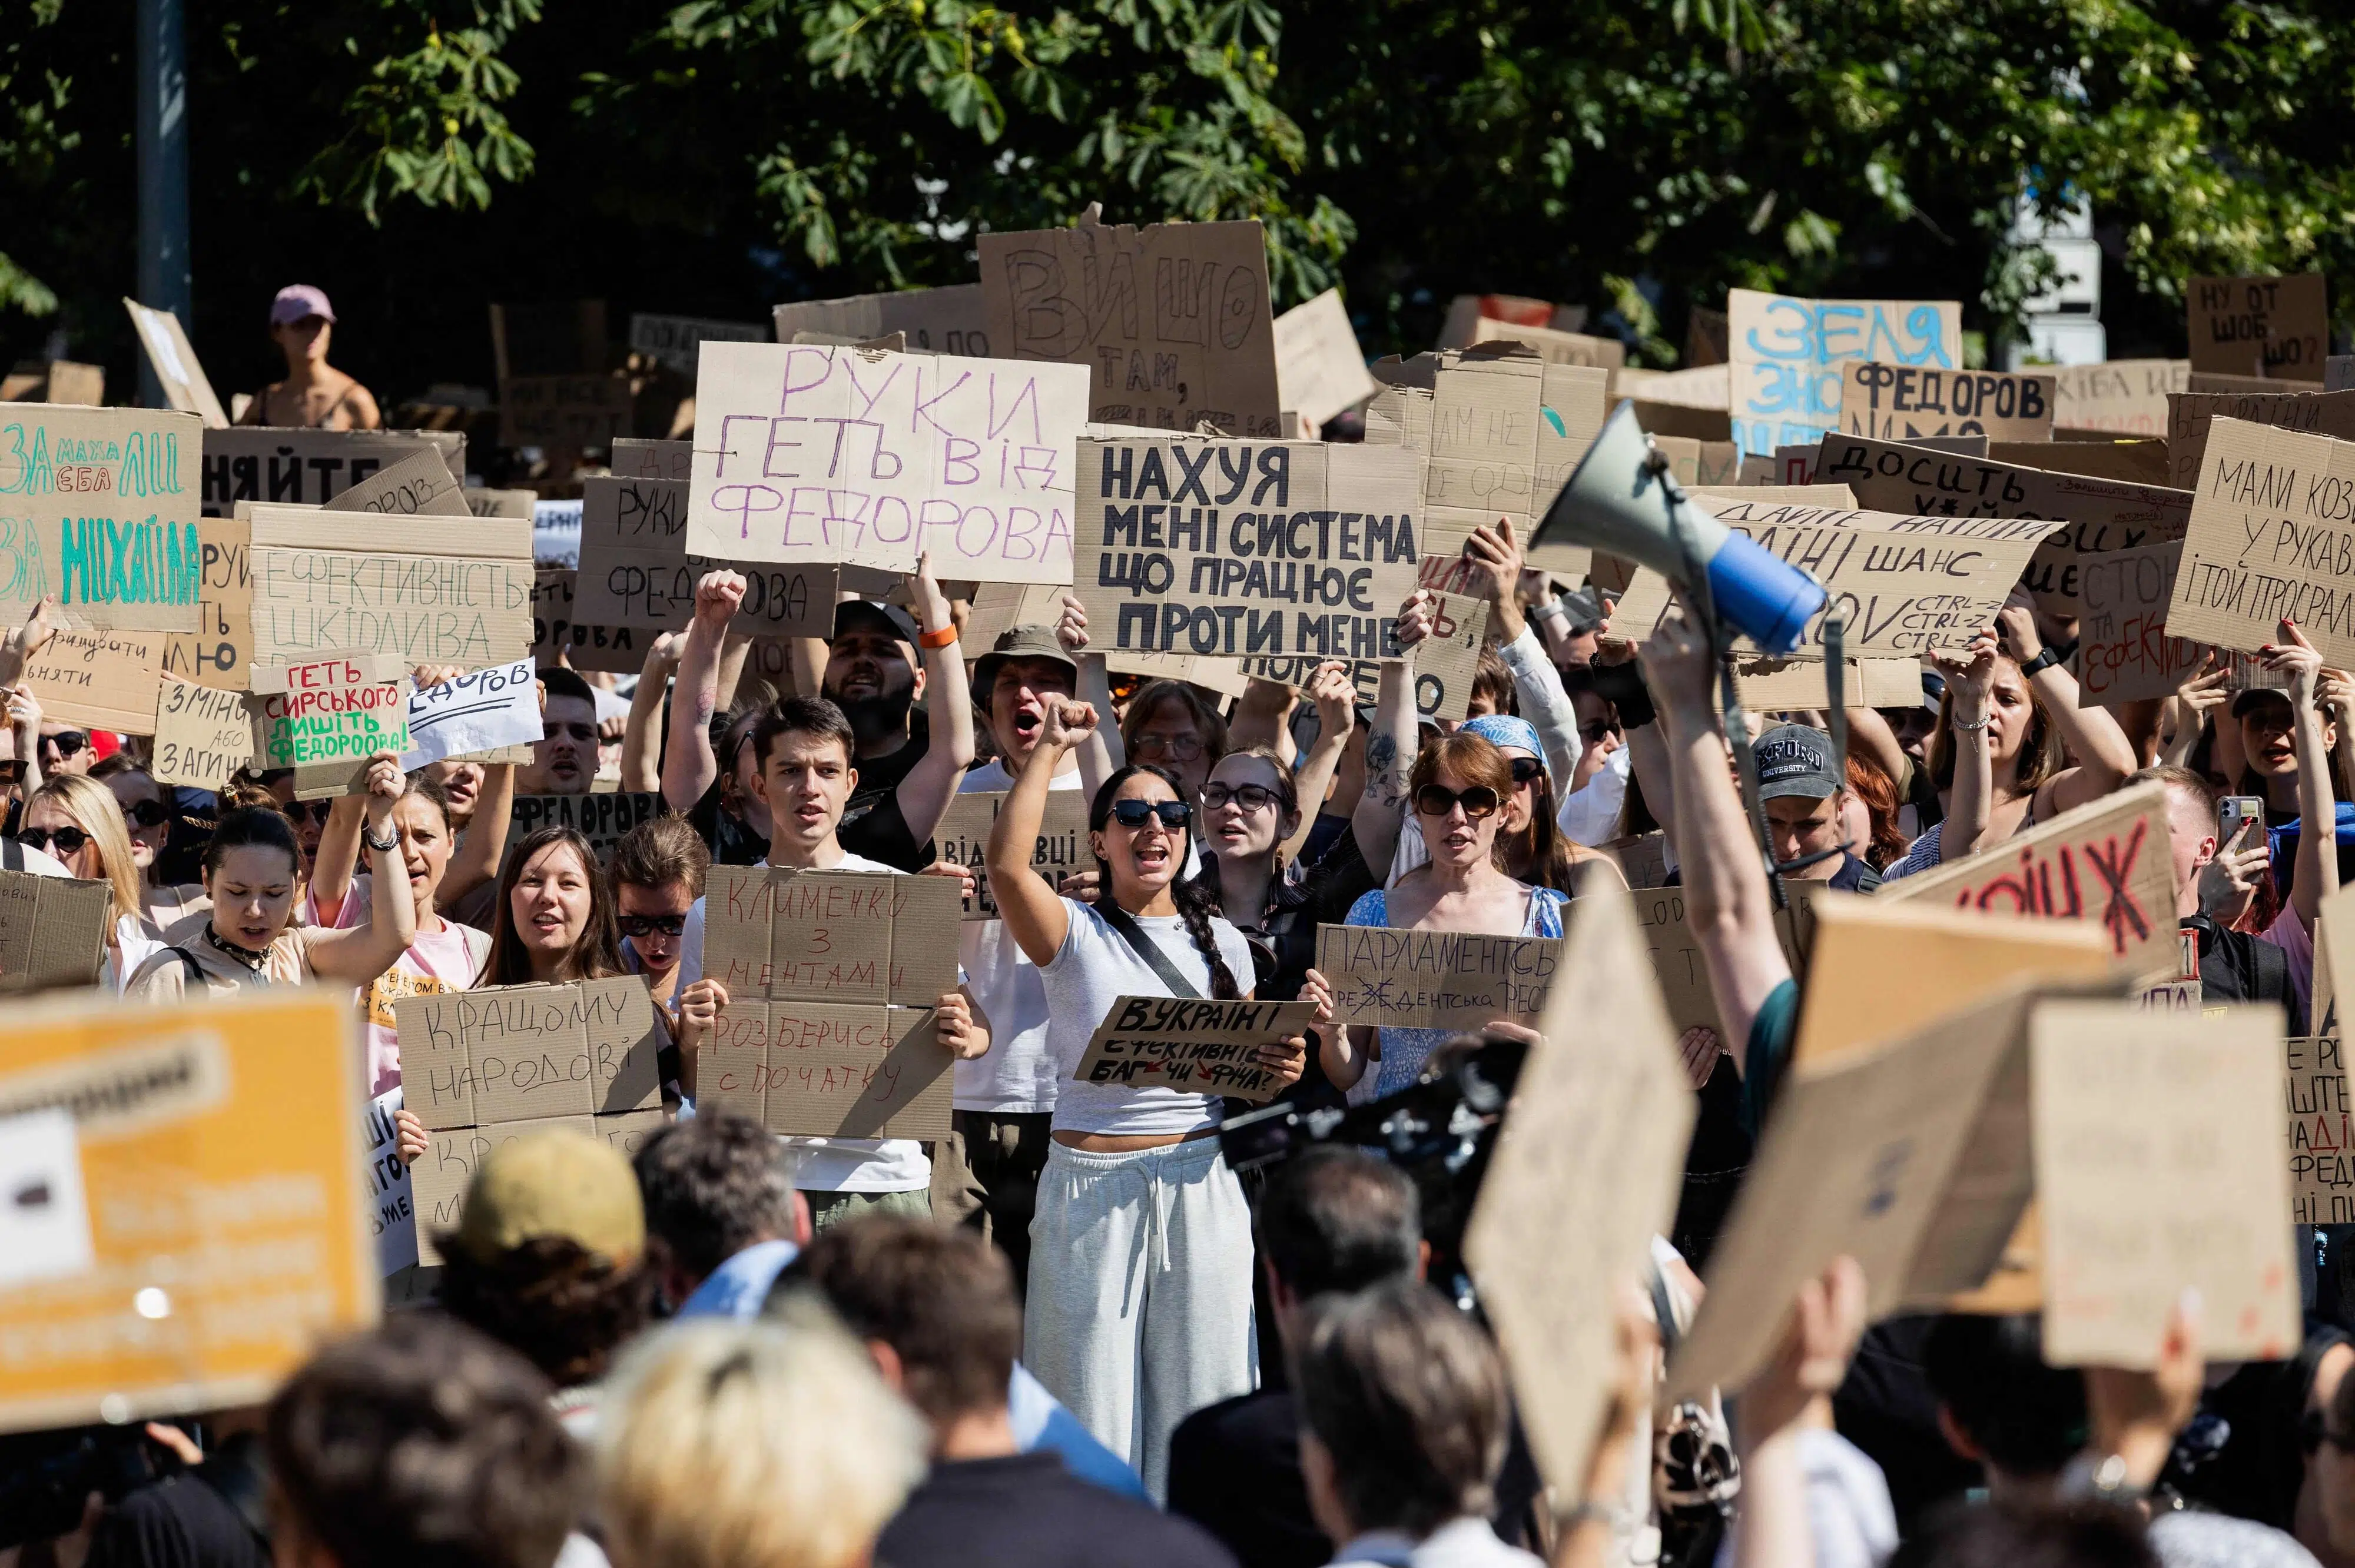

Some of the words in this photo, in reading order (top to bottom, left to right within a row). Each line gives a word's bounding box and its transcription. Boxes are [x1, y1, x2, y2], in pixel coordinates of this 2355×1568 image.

[2200, 284, 2232, 312] НУ
[2248, 282, 2280, 312] ОТ
[1746, 298, 1953, 368] ЗЕЛЯ
[781, 348, 1041, 444] РУКИ
[1097, 346, 1188, 405] ТАМ,
[1855, 361, 2045, 419] ФЕДОРОВ
[716, 415, 903, 479] ГЕТЬ
[944, 437, 1058, 491] ВІД
[1100, 446, 1289, 507] НАХУЯ
[2213, 456, 2296, 512] МАЛИ
[711, 484, 1074, 564] ФЕДОРОВА
[1102, 504, 1218, 554] МЕНІ
[1230, 510, 1417, 564] СИСТЕМА
[2240, 513, 2270, 557] У
[2273, 520, 2355, 576] РУКАВ
[266, 551, 525, 610] ЕФЕКТИВНІСТЬ
[1098, 552, 1175, 597] ЩО
[1189, 557, 1374, 612] ПРАЦЮЄ
[1862, 545, 1982, 577] ШАНС
[1902, 613, 1988, 630] CTRL-Z
[2199, 560, 2249, 613] ТОЙ
[2248, 574, 2355, 639] ПРОСРАЛ
[271, 605, 491, 660] ШКІДЛИВА
[1117, 602, 1283, 655] ПРОТИ
[1296, 612, 1404, 659] МЕНЕ
[265, 686, 398, 719] СИРСЬКОГО
[288, 660, 361, 688] ГЕТЬ
[209, 730, 245, 750] АБО
[1762, 765, 1807, 777] UNIVERSITY
[728, 877, 908, 924] КЛИМЕНКО
[809, 928, 831, 954] З
[727, 958, 904, 990] МЕНТАМИ
[425, 991, 628, 1051] КРАЩОМУ
[431, 1035, 631, 1106] НАРОДОВІ
[1089, 1059, 1150, 1082] БАГ
[1166, 1062, 1195, 1083] ЧИ
[1210, 1062, 1276, 1092] ФІЧА?
